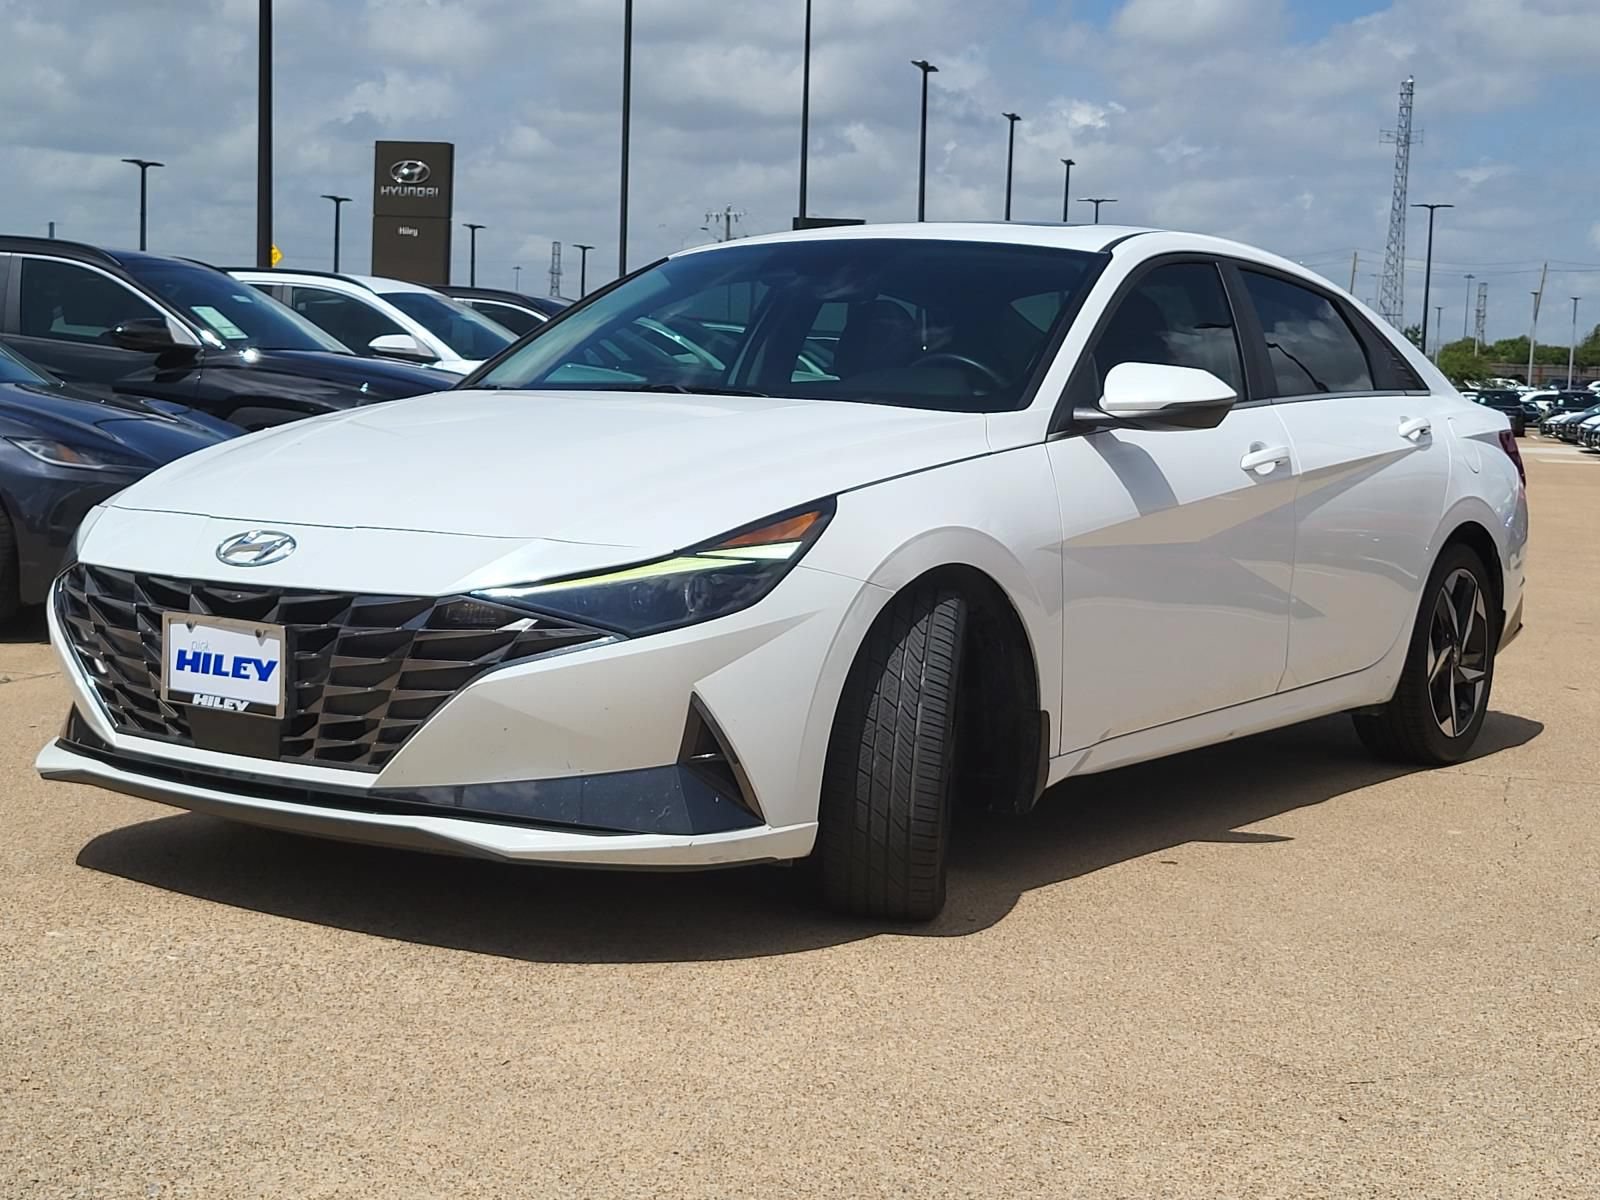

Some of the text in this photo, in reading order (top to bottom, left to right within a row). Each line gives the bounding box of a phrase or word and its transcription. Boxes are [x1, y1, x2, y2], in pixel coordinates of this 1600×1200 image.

[381, 185, 439, 197] HYUNDAI
[398, 226, 418, 237] Hiley
[176, 648, 278, 682] HILEY
[192, 693, 250, 712] HILEY
